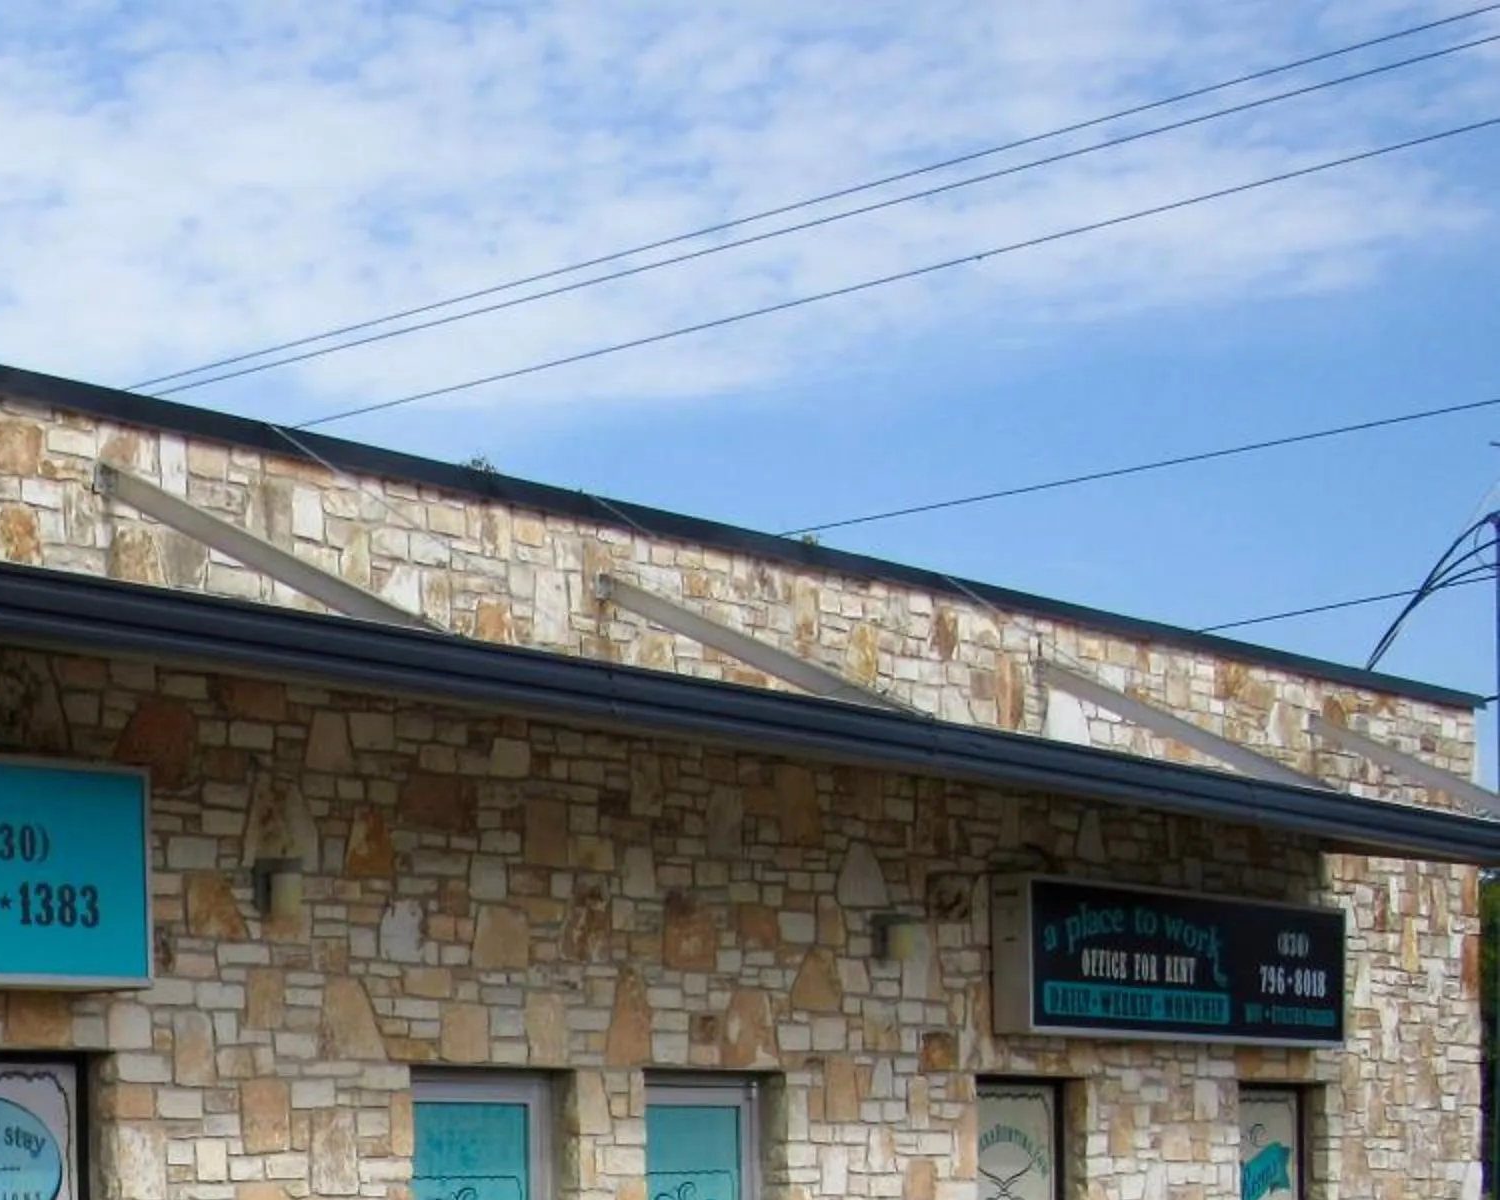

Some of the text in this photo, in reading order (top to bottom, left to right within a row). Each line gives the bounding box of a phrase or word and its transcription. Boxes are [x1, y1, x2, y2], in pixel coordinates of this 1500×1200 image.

[1065, 903, 1125, 956] place
[1134, 906, 1158, 935] to
[1081, 948, 1197, 985] OFFICE FOR RENT
[4, 1125, 46, 1158] stay
